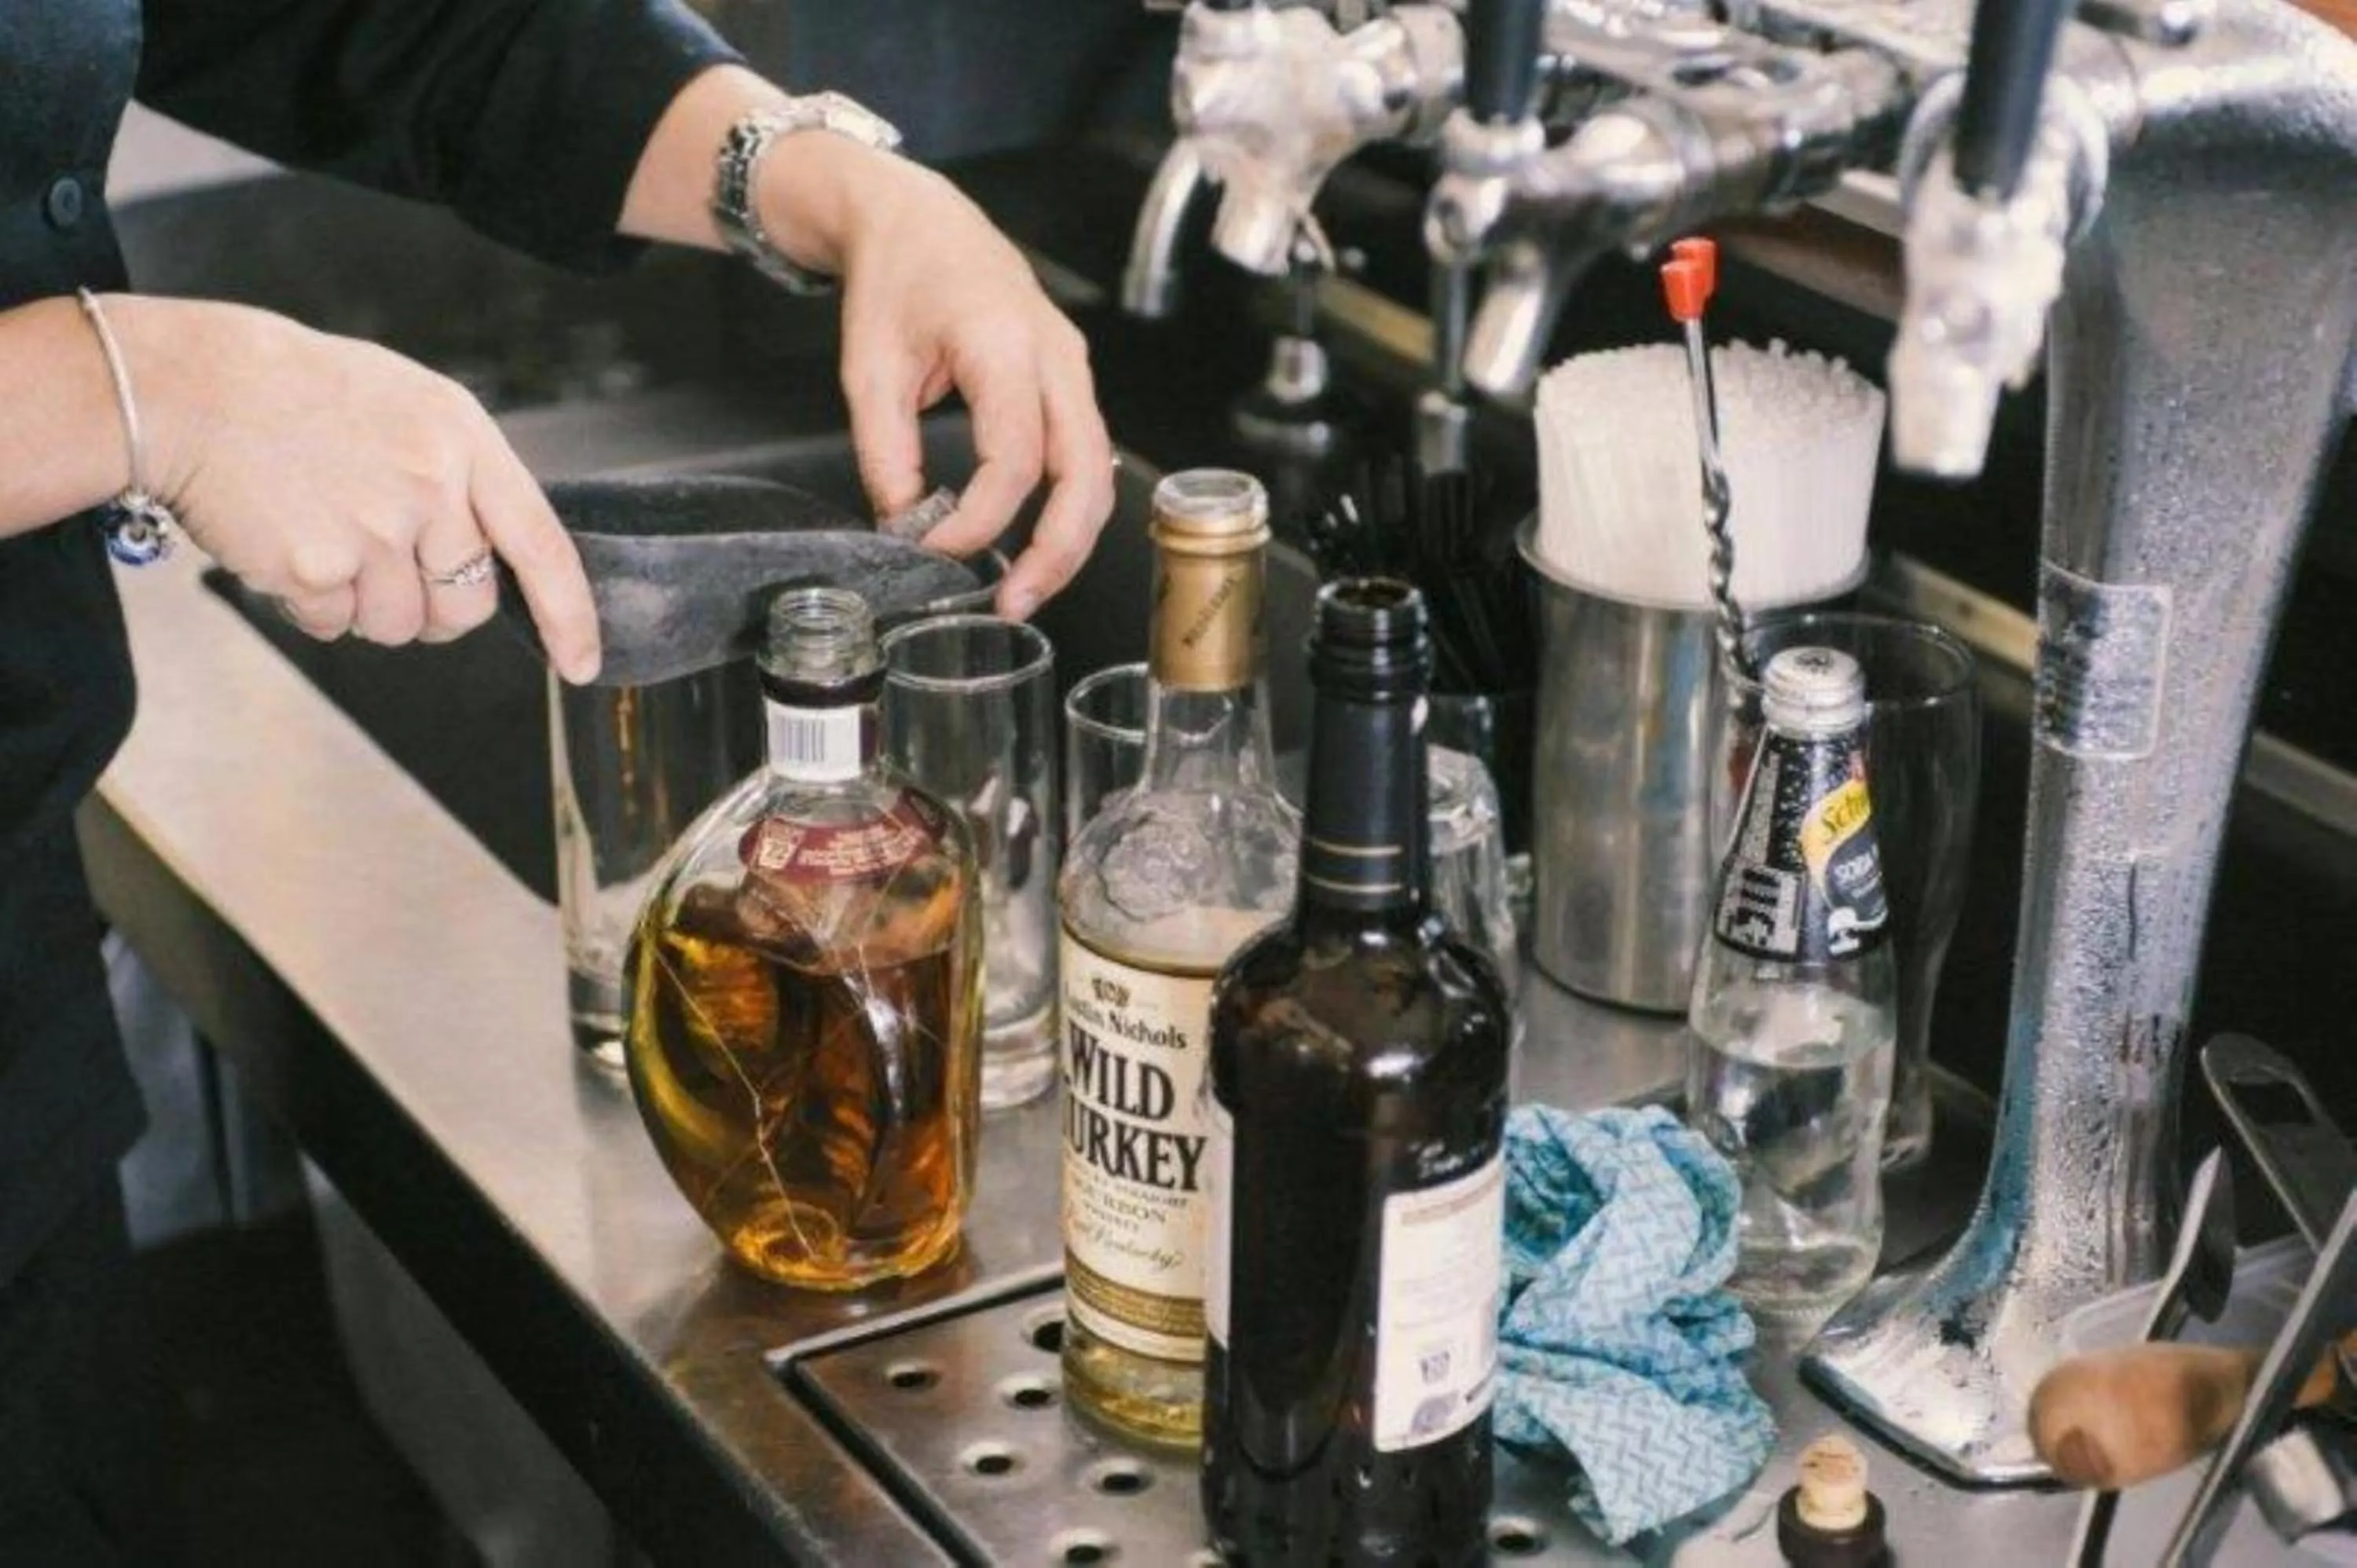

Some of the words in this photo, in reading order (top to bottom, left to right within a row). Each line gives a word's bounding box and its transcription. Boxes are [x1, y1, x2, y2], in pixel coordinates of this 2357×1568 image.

[1069, 1018, 1175, 1121] WILD
[1109, 1009, 1187, 1049] Nichols
[1063, 1075, 1208, 1192] URKEY
